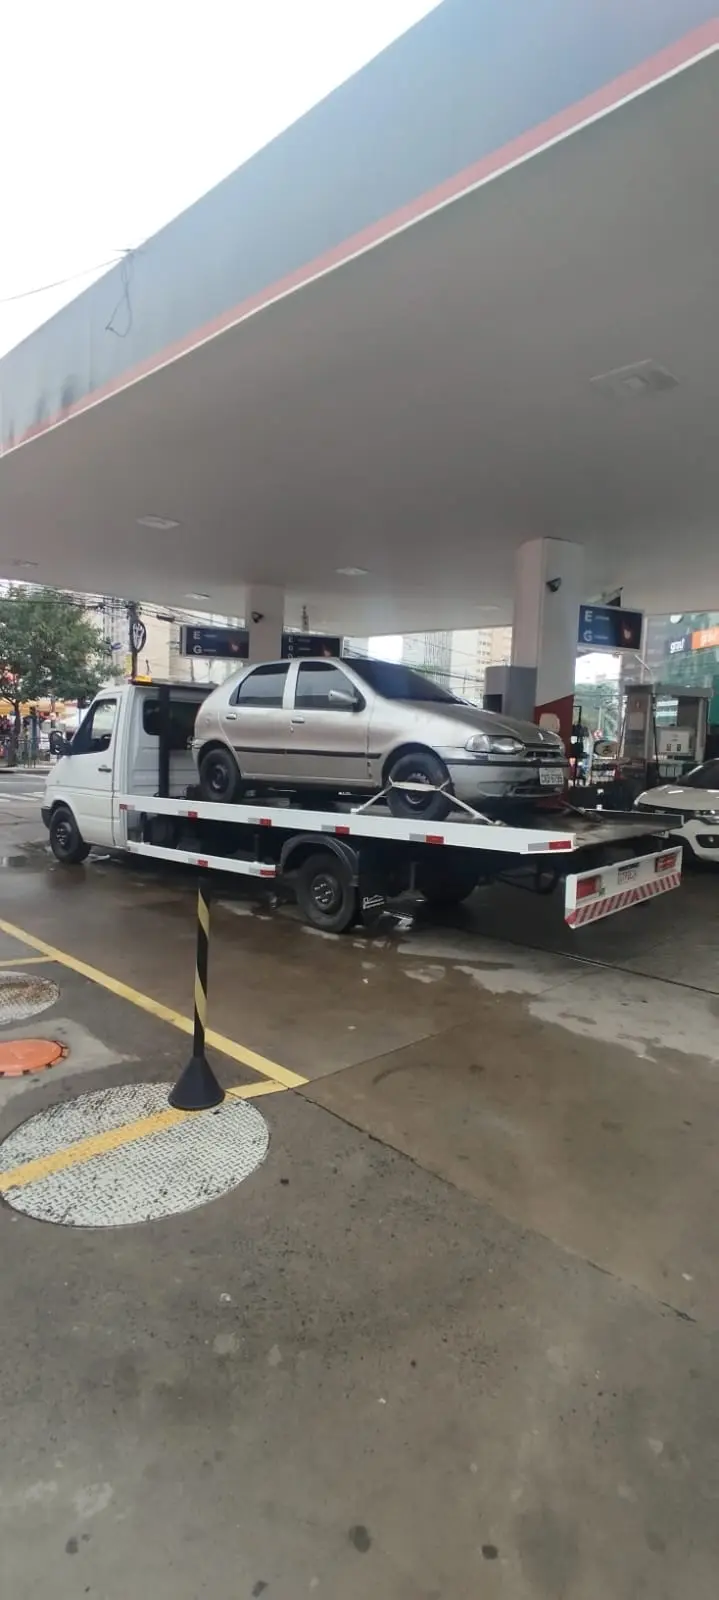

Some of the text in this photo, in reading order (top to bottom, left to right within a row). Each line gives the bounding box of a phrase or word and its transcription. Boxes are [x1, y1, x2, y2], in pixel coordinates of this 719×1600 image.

[584, 610, 593, 622] E
[192, 631, 201, 640] E
[583, 630, 593, 642] G
[192, 645, 203, 654] G
